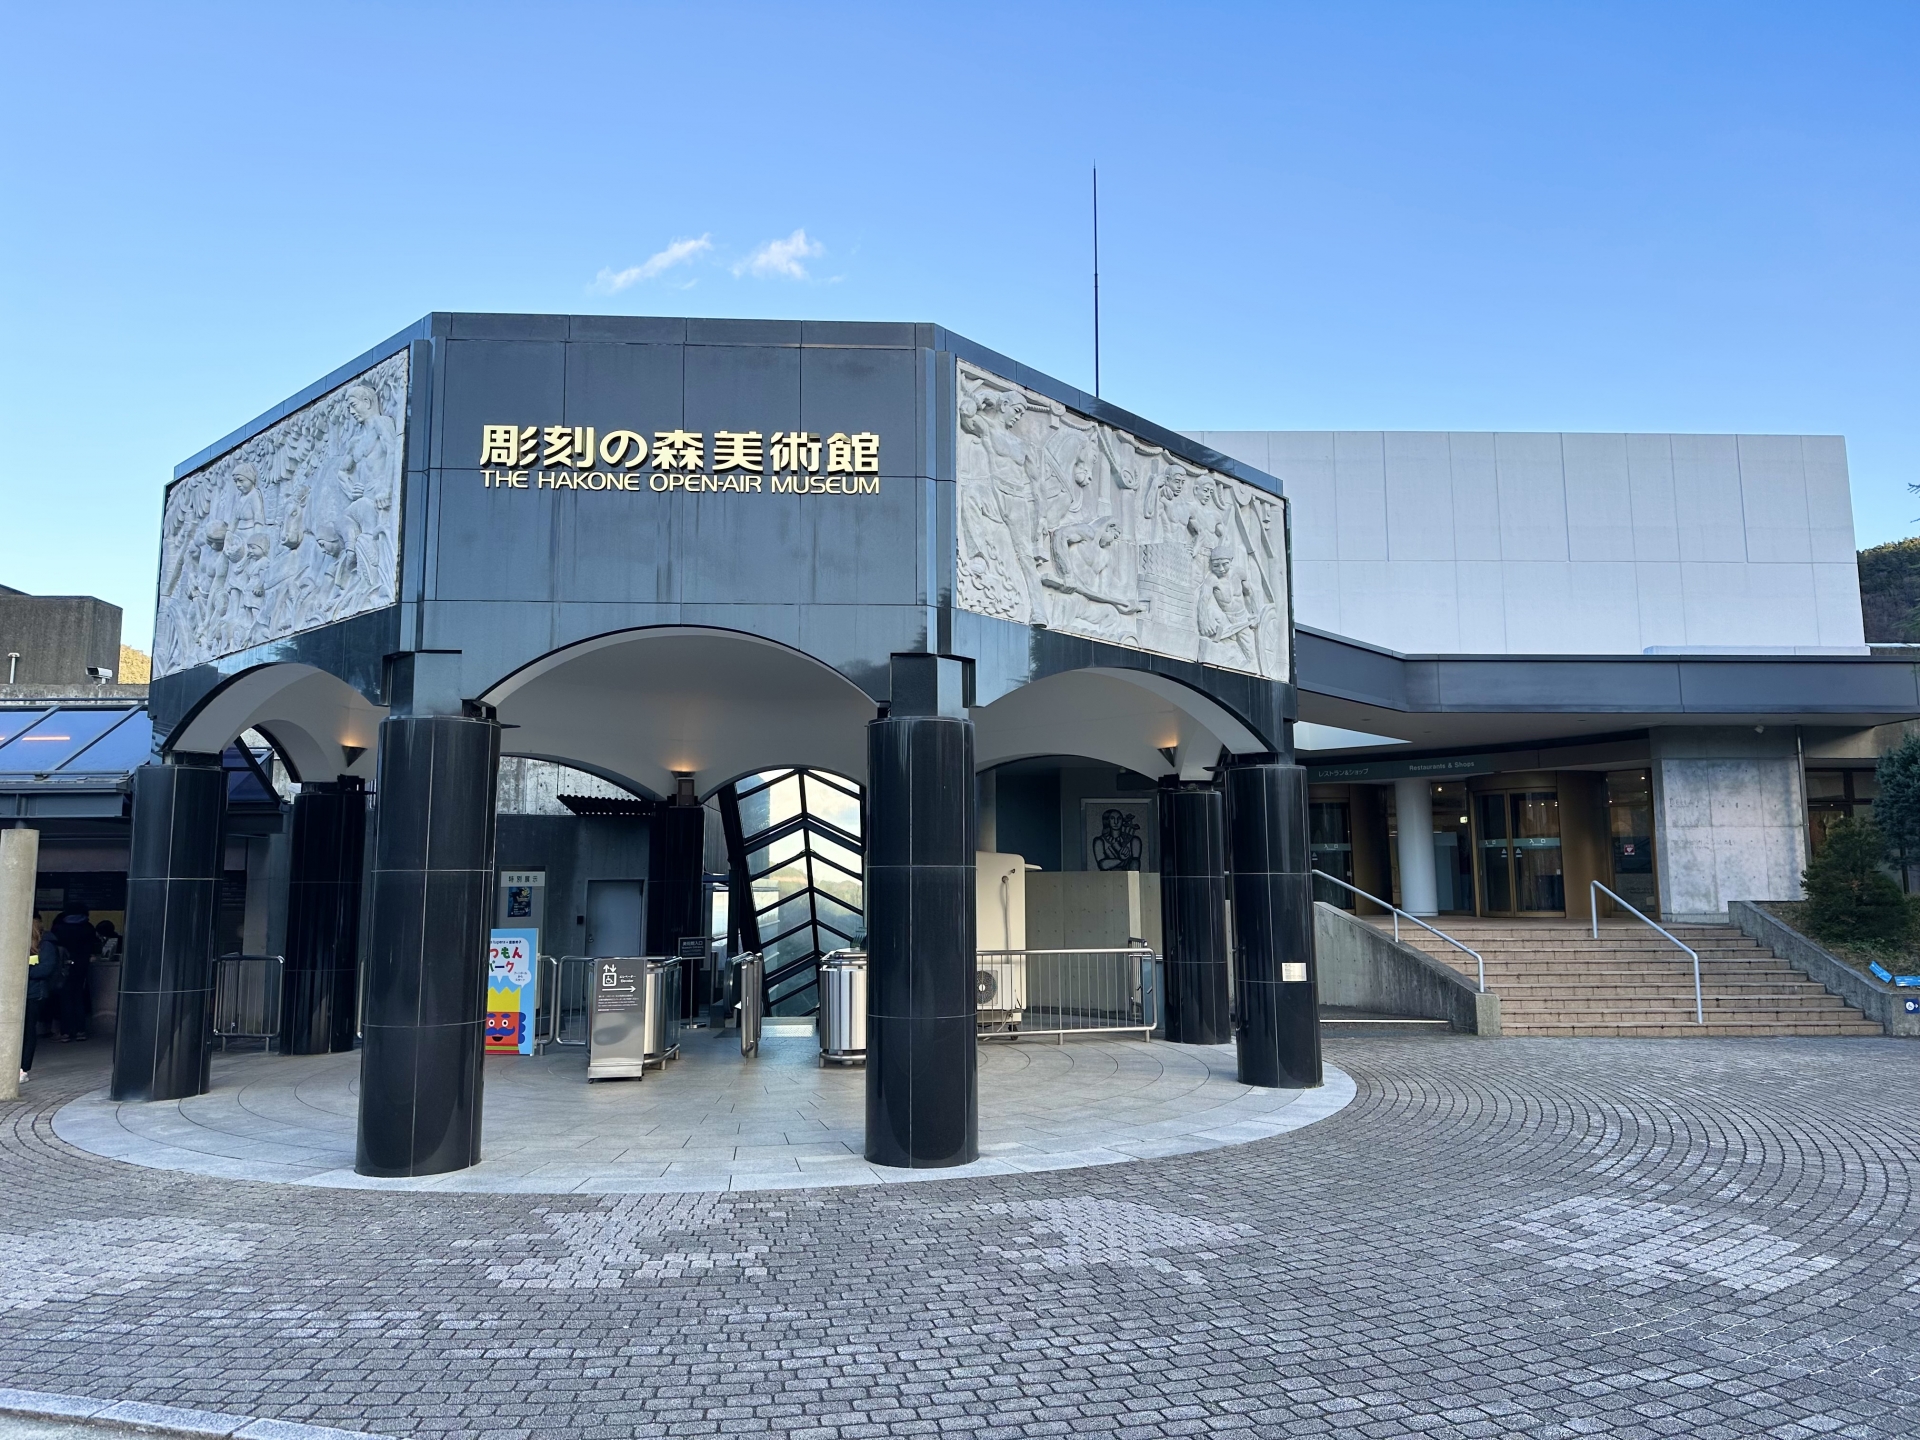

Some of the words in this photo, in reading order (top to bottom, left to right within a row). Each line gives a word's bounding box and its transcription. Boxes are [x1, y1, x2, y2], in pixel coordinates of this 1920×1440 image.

[480, 425, 880, 474] 彫刻の森美術館
[479, 470, 529, 488] THE
[538, 471, 640, 491] HAKONE
[650, 473, 762, 493] OPEN-AIR
[771, 475, 880, 494] MUSEUM
[1409, 763, 1446, 771] Restaurants
[1454, 761, 1475, 769] Shops
